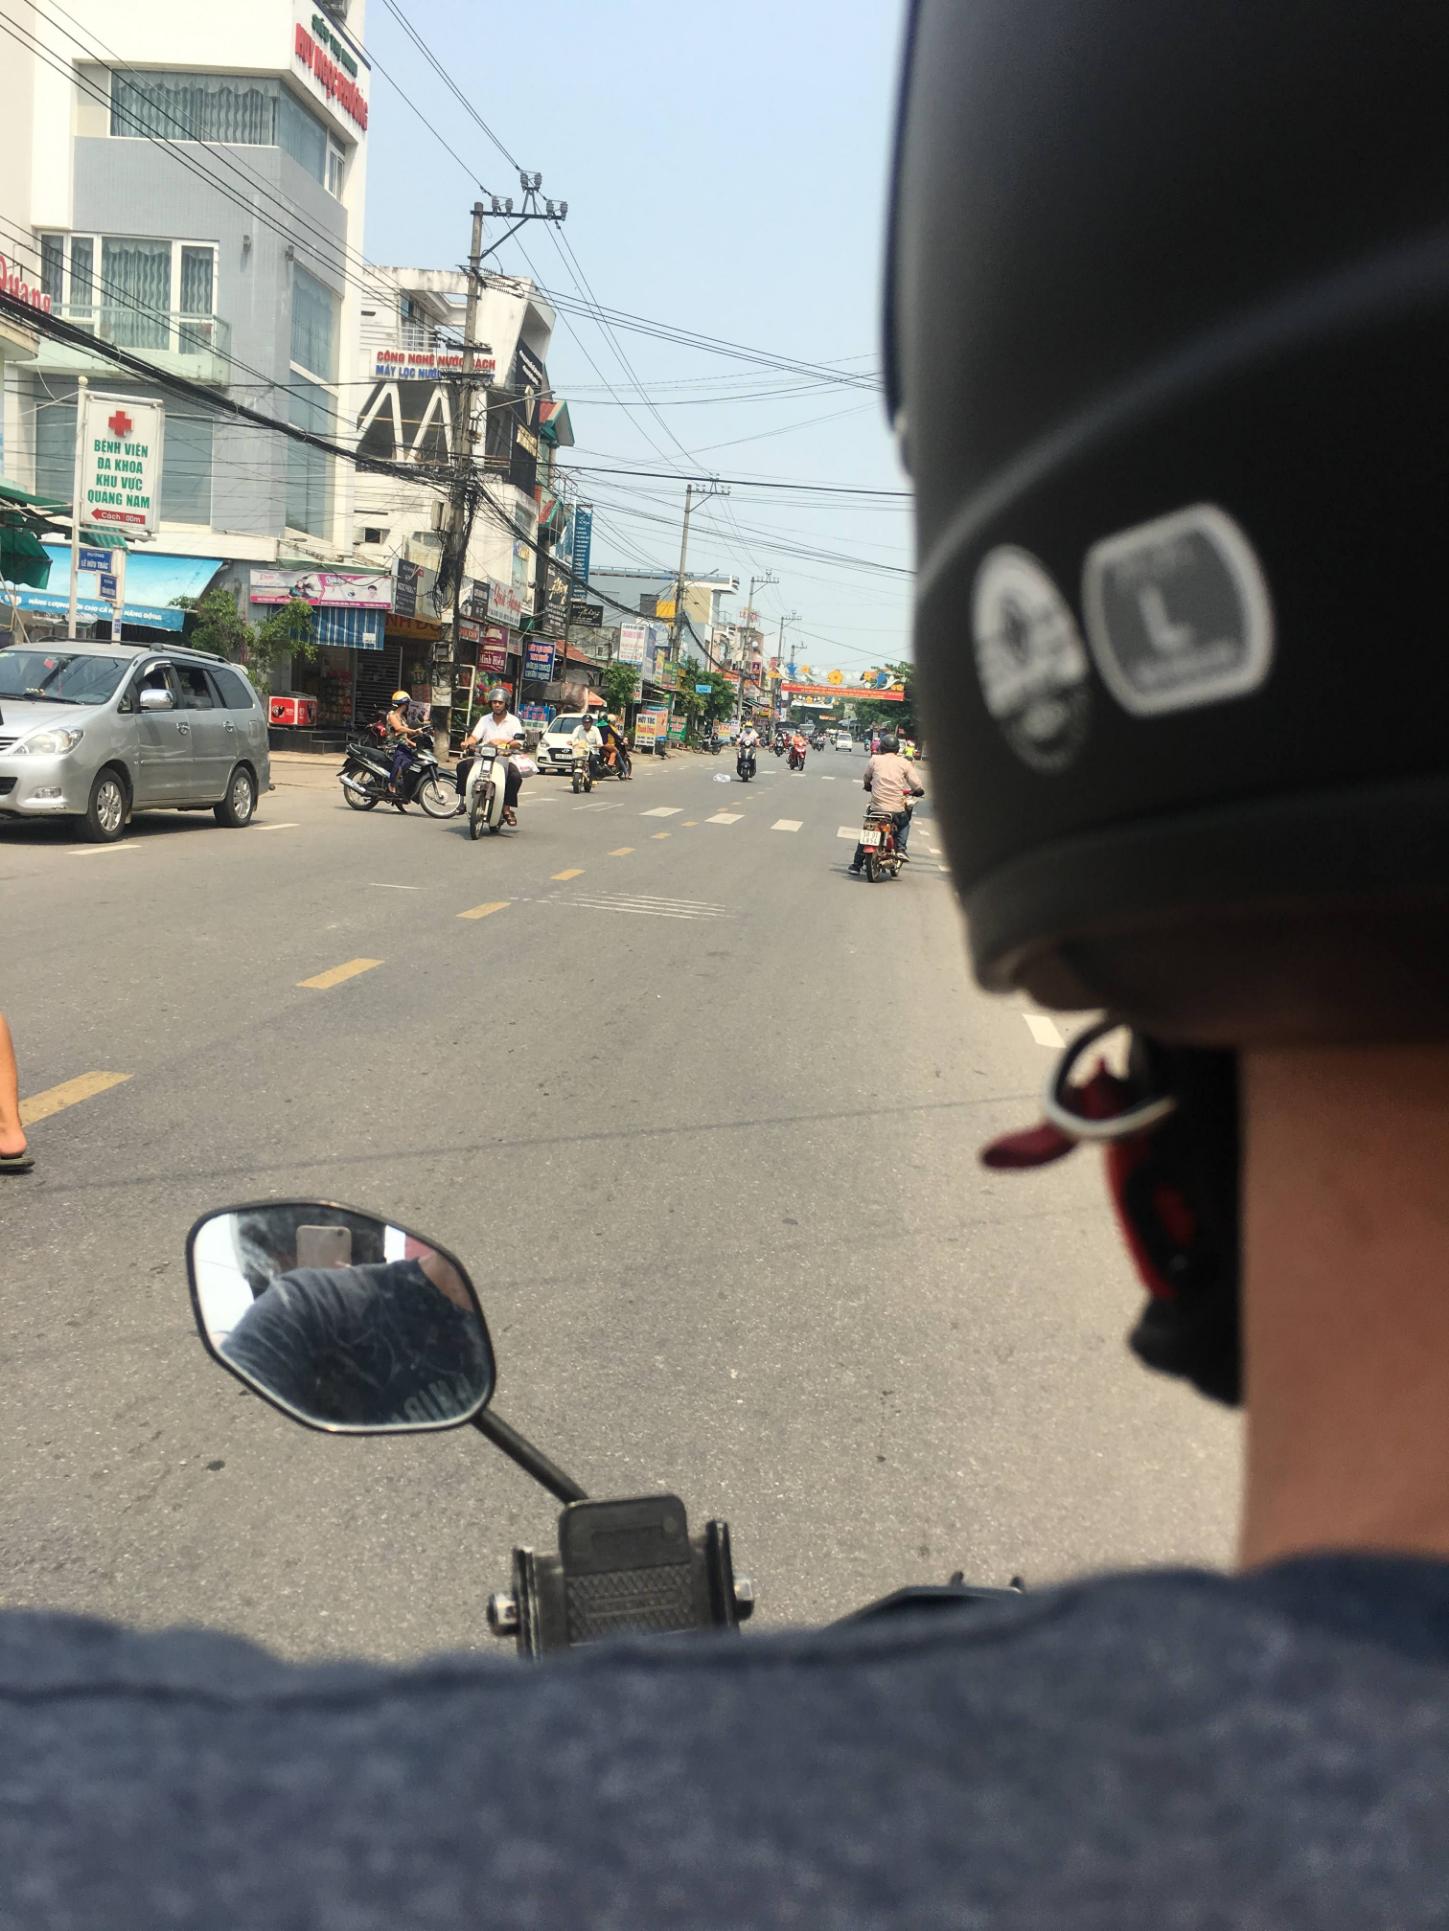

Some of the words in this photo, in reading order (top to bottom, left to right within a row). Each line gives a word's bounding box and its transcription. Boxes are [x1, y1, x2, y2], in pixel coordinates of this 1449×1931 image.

[376, 350, 405, 363] CÔNG
[408, 352, 435, 367] NGHỆ
[375, 363, 396, 377] MÁY
[399, 367, 415, 379] LỌC
[94, 438, 121, 455] BỆNH
[124, 442, 149, 459] VIỆN
[97, 456, 111, 470] ĐA
[114, 458, 143, 474] KHOA
[96, 473, 118, 488] KHU
[120, 476, 143, 492] VỰC
[87, 488, 123, 506] QUẢNG
[126, 494, 150, 509] NAM
